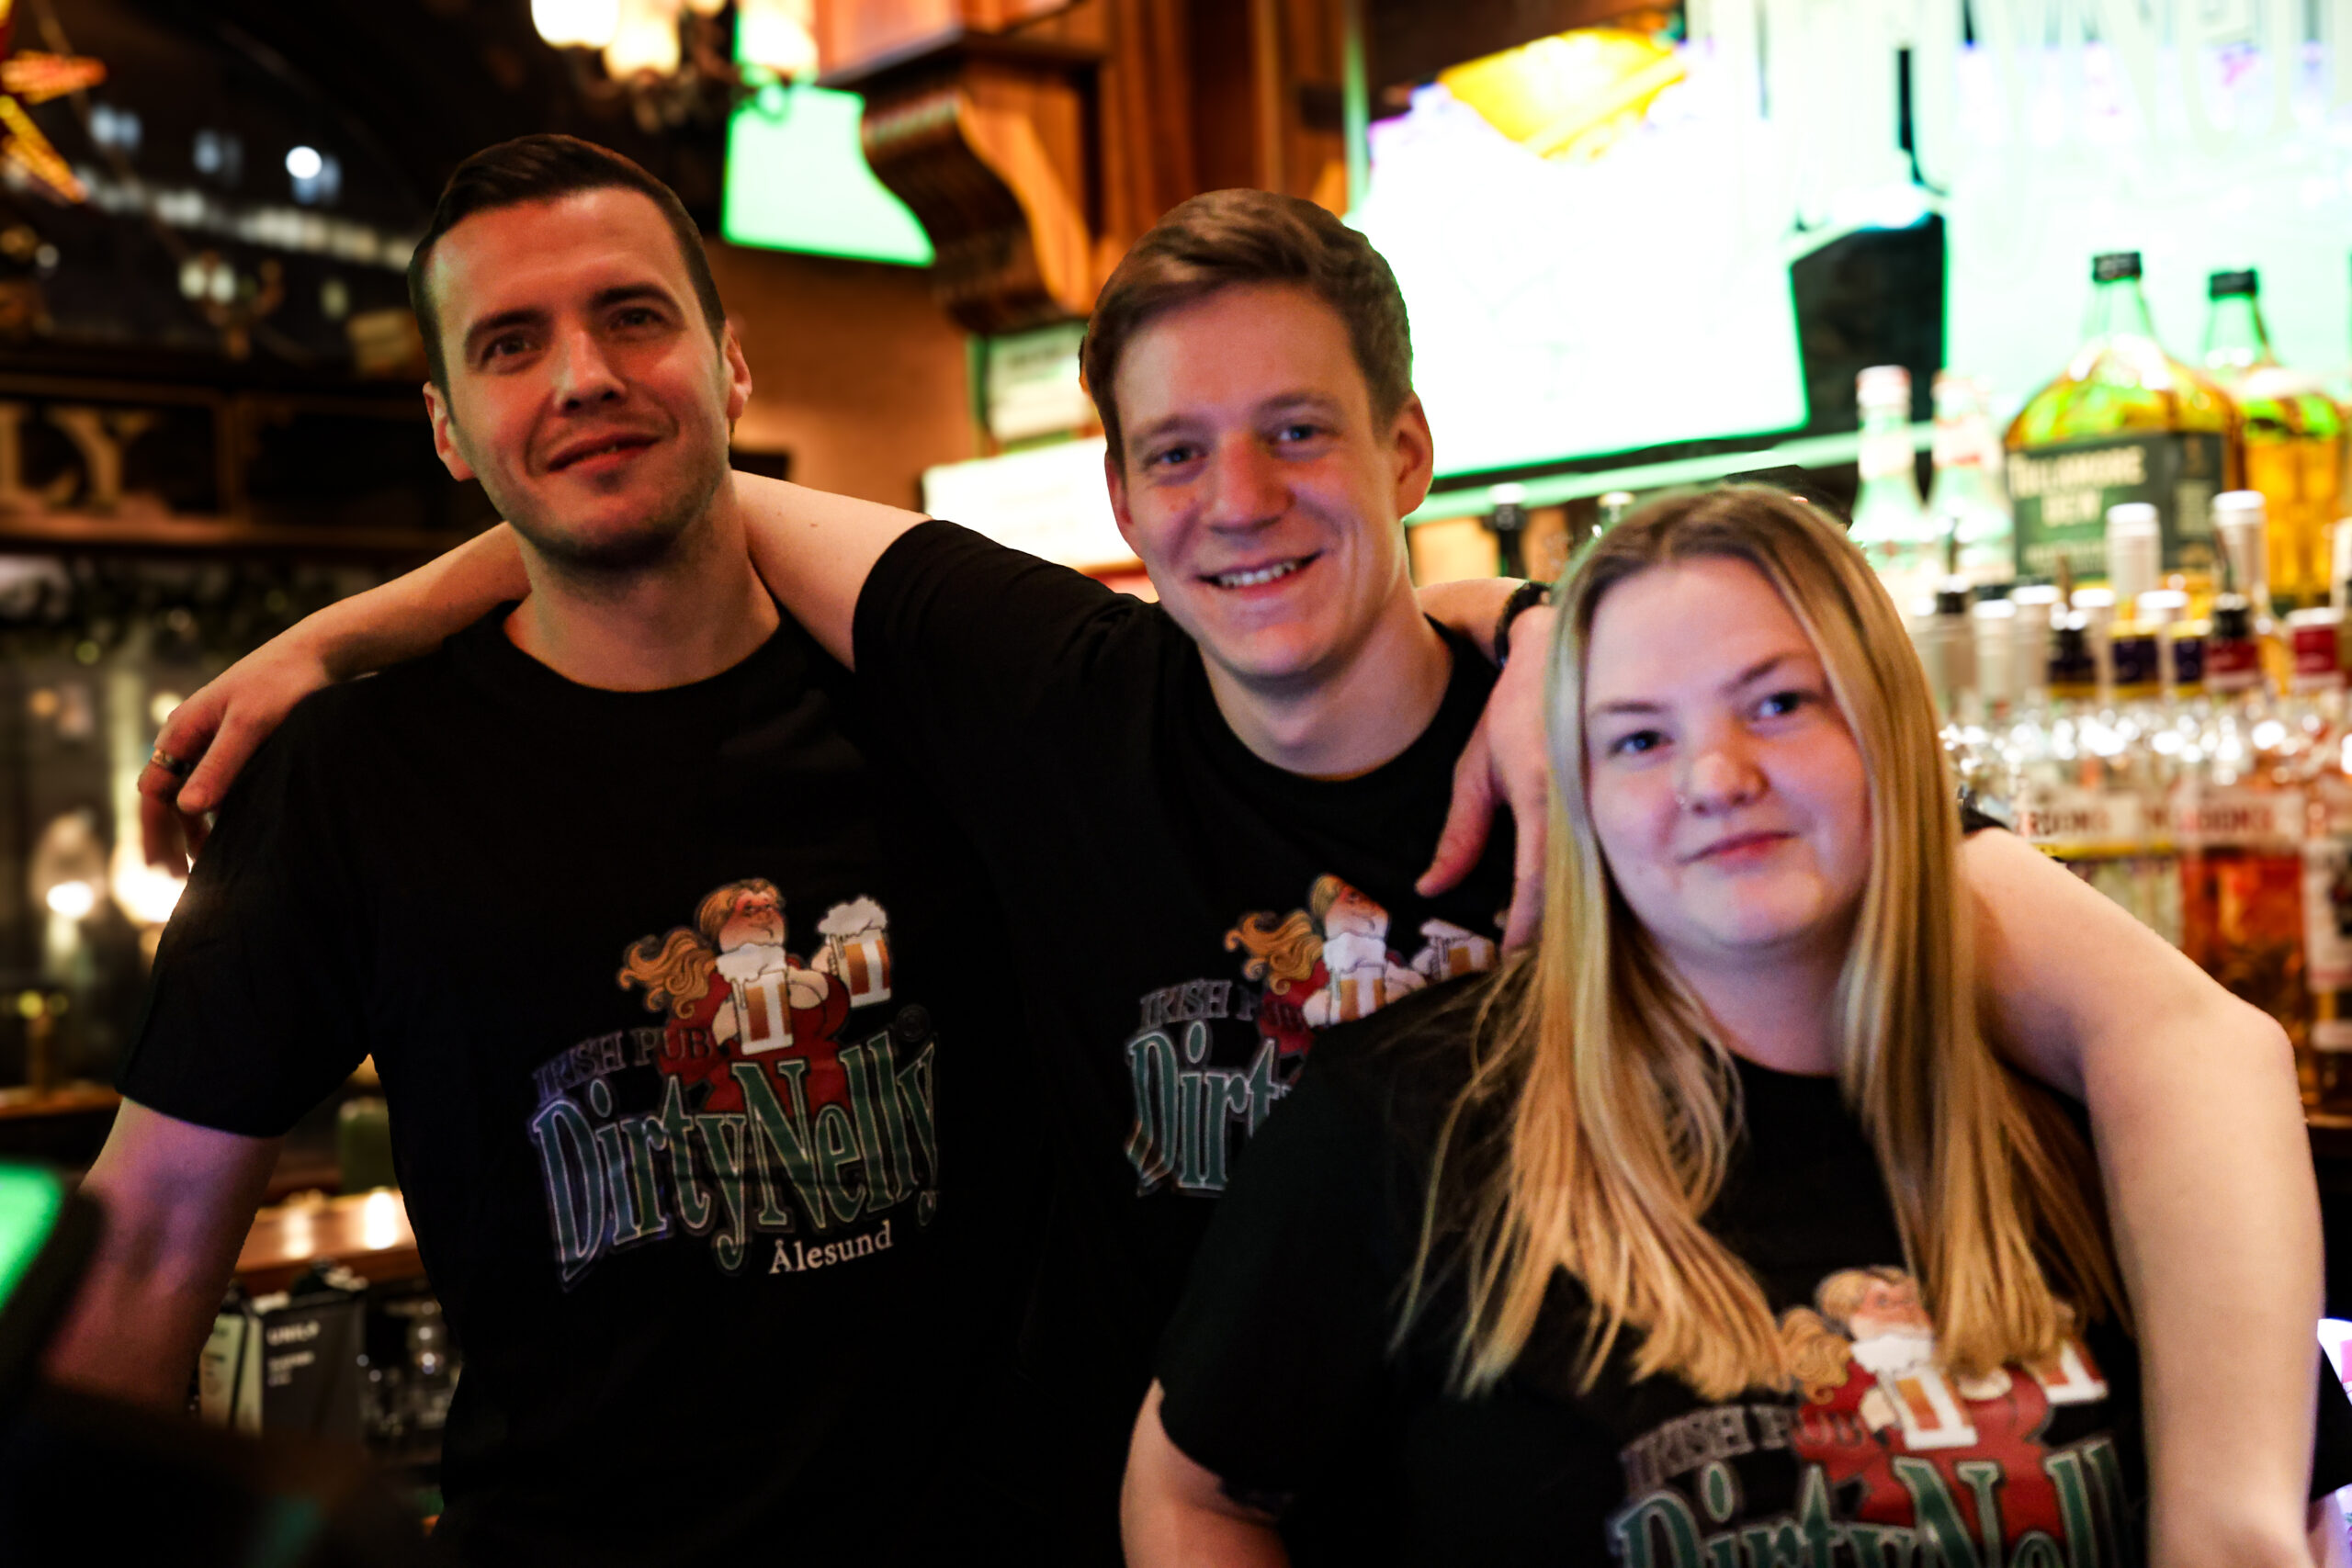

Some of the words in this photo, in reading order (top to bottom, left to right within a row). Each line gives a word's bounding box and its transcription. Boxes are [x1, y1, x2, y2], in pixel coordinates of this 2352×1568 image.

[1140, 977, 1233, 1031] IRISH
[533, 1030, 624, 1106] IRISH
[631, 1027, 714, 1066] PUB
[768, 1218, 894, 1275] Ålesund
